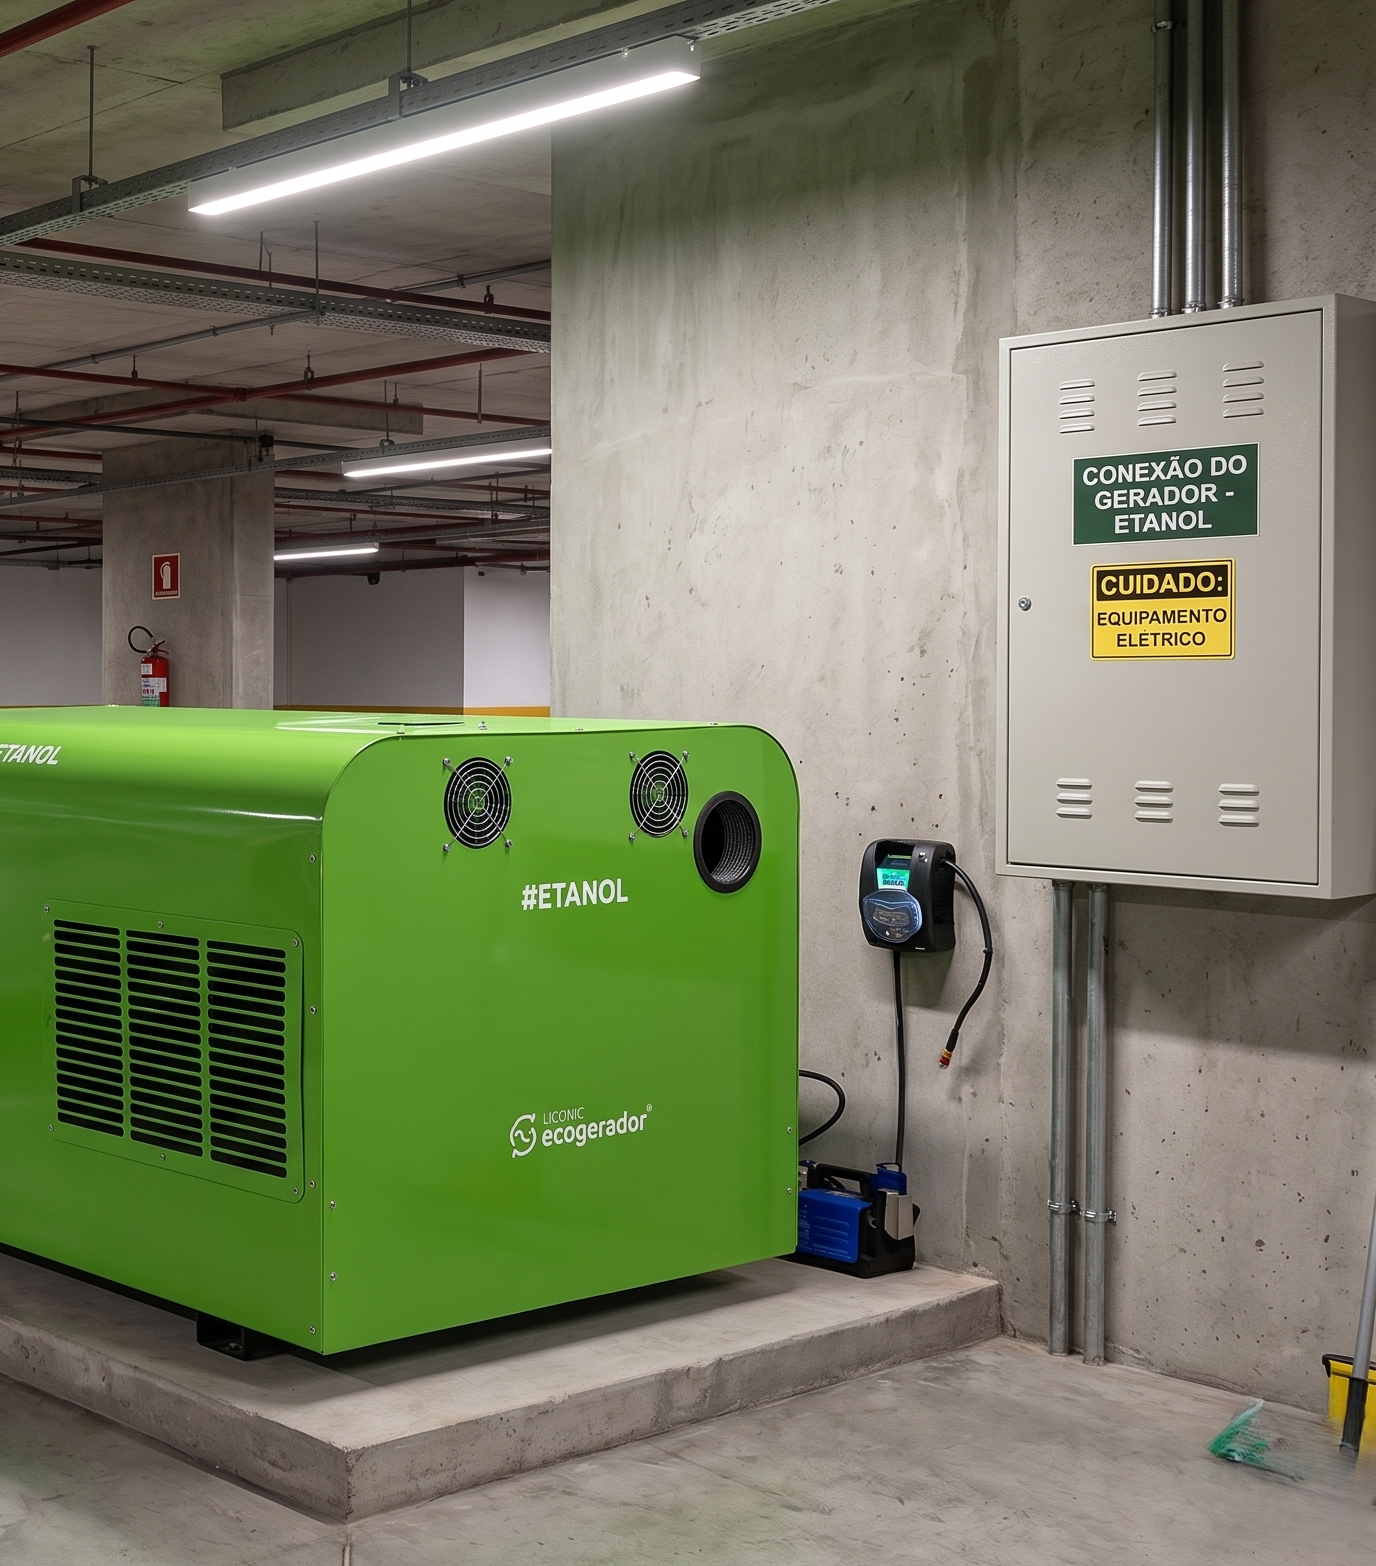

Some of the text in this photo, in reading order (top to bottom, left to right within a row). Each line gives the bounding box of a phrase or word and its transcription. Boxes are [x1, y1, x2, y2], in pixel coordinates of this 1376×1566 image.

[1082, 454, 1248, 486] CONEXÃO DO
[1094, 483, 1219, 510] GERADOR
[1114, 510, 1213, 534] ETANOL
[1100, 571, 1224, 596] CUIDADO:
[1097, 608, 1228, 627] EQUIPAMENTO
[1116, 629, 1206, 648] ELÉTRICO
[521, 877, 629, 911] #ETANOL
[543, 1106, 585, 1125] LICONIC
